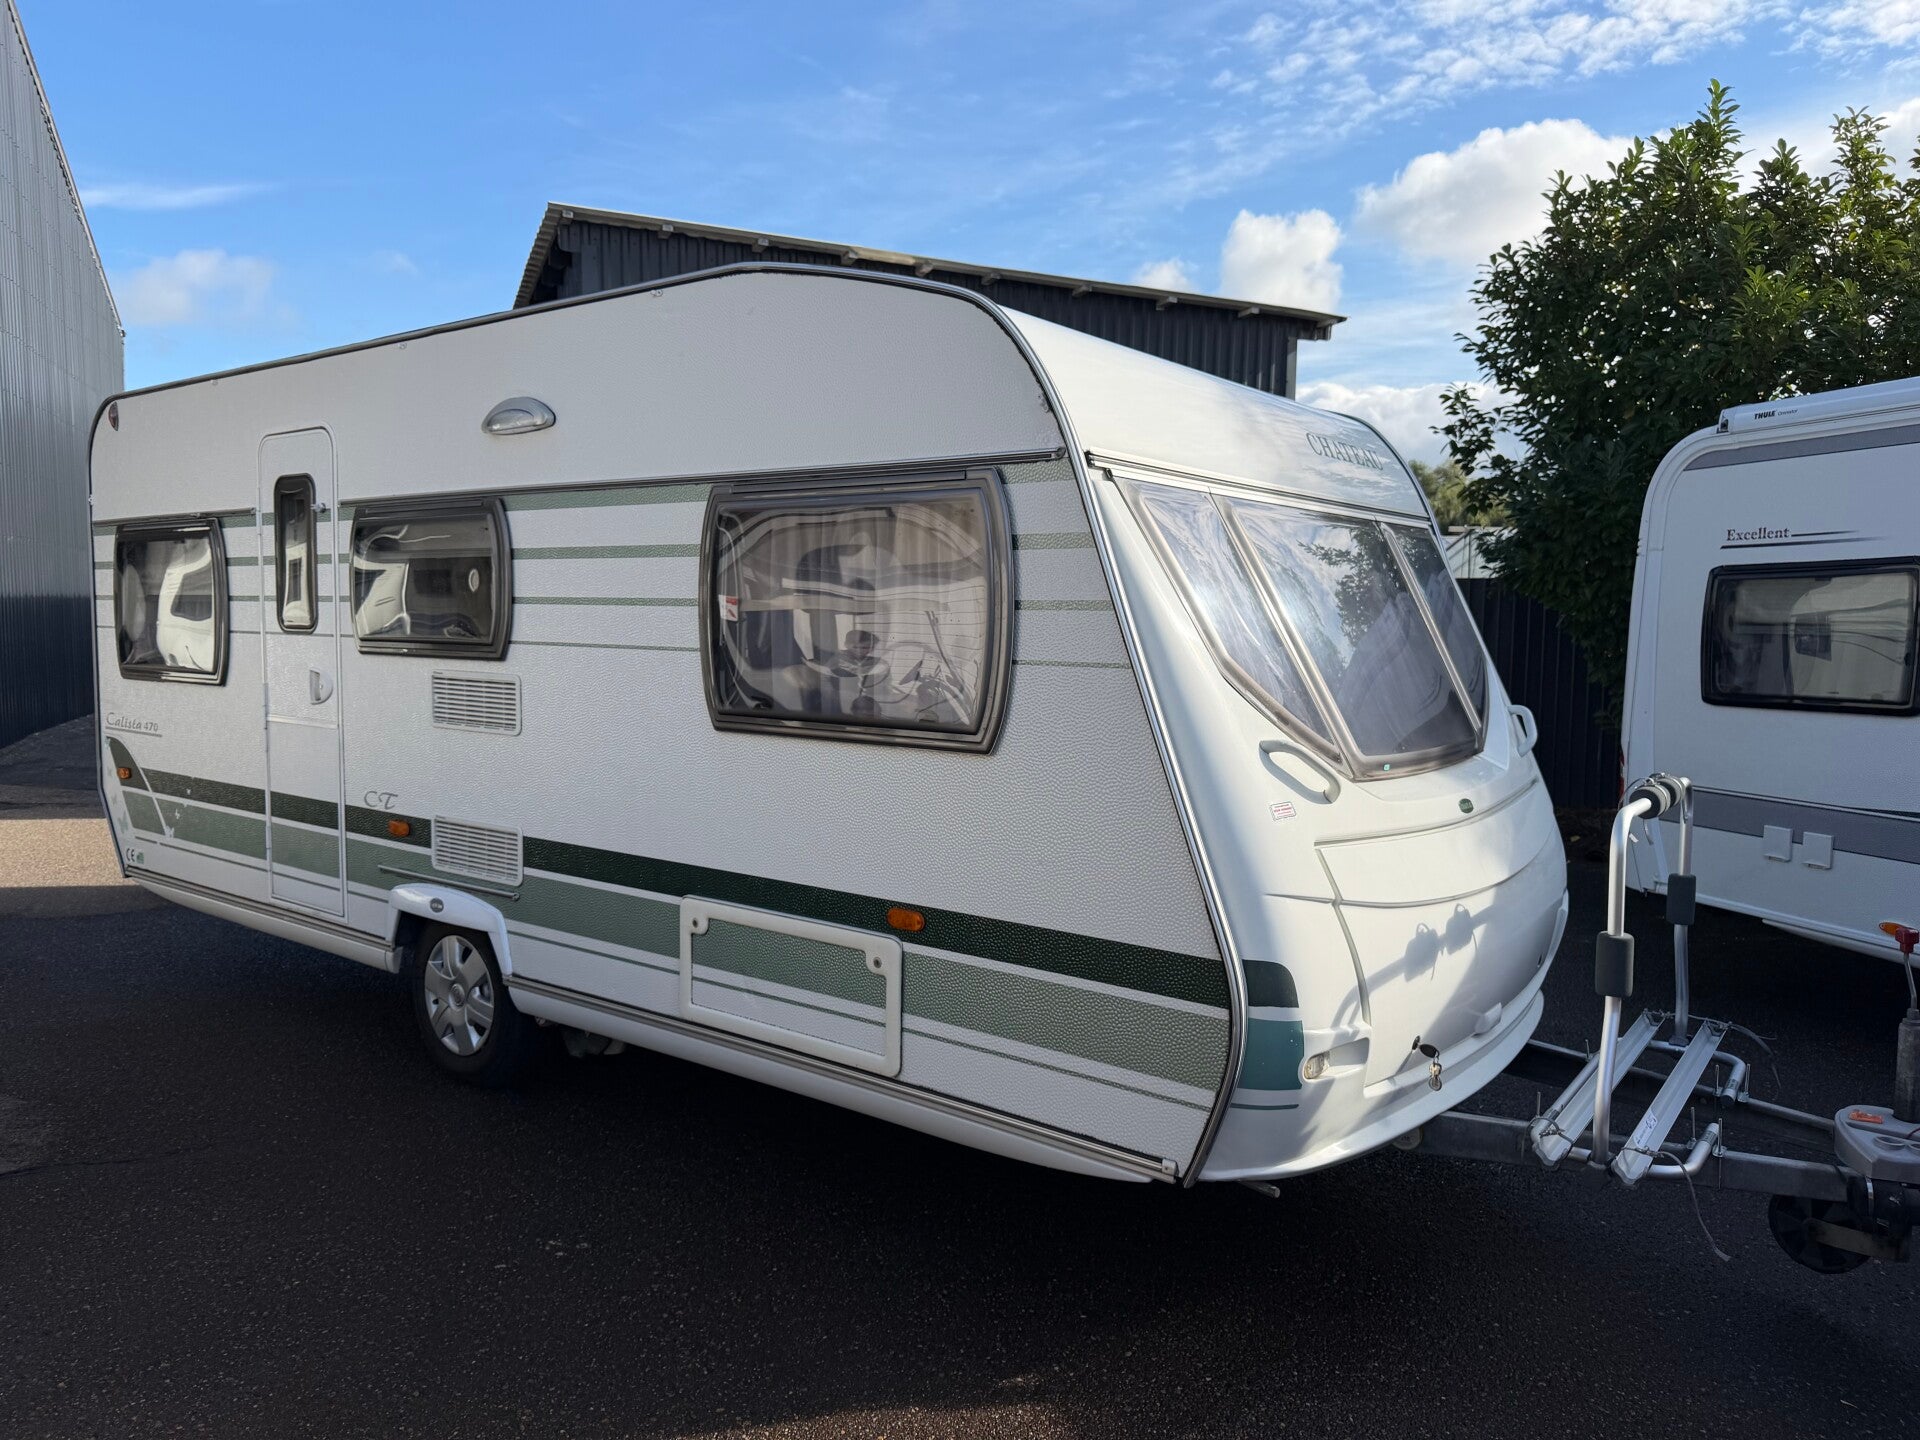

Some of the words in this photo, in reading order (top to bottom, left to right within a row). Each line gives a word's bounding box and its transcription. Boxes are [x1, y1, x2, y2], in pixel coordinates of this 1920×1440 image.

[1754, 410, 1776, 420] THULE
[1306, 432, 1383, 471] CHATEAU
[1726, 527, 1790, 541] Excellent
[106, 712, 142, 730] Calista
[143, 721, 159, 732] 470
